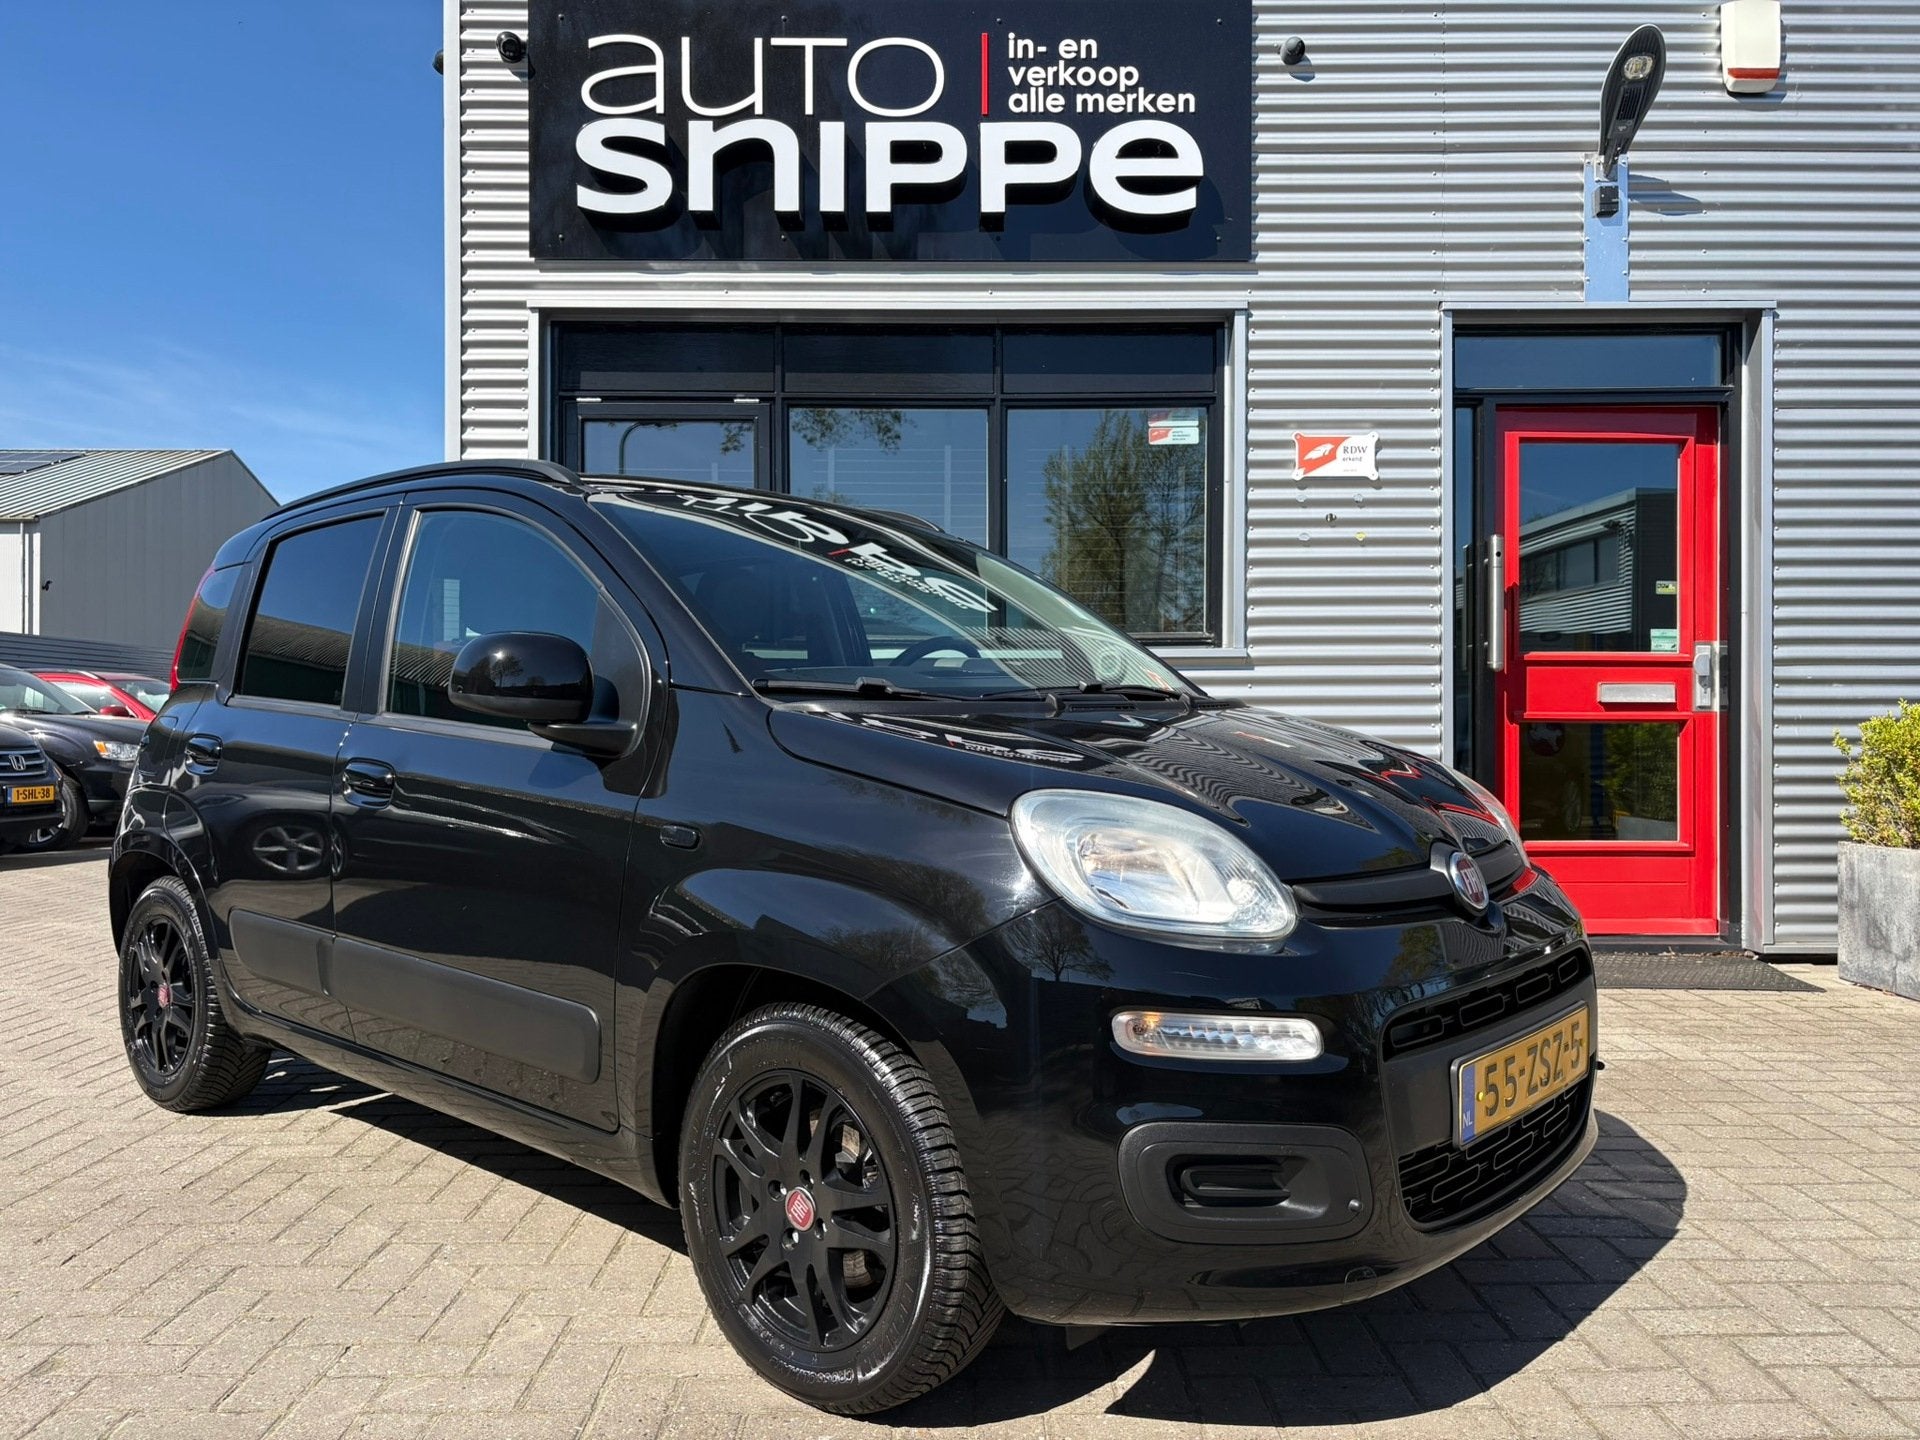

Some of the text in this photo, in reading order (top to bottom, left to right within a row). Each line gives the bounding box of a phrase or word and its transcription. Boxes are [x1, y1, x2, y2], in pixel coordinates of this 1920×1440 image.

[1008, 32, 1098, 59] in- en
[1007, 60, 1140, 92] verkoop
[1008, 87, 1196, 113] alle merken
[1343, 445, 1368, 455] RDW
[16, 788, 51, 801] 1-SHL-38
[1484, 1020, 1581, 1117] 55-ZSZ-5
[1462, 1111, 1473, 1129] NL
[790, 1194, 809, 1223] FIAT
